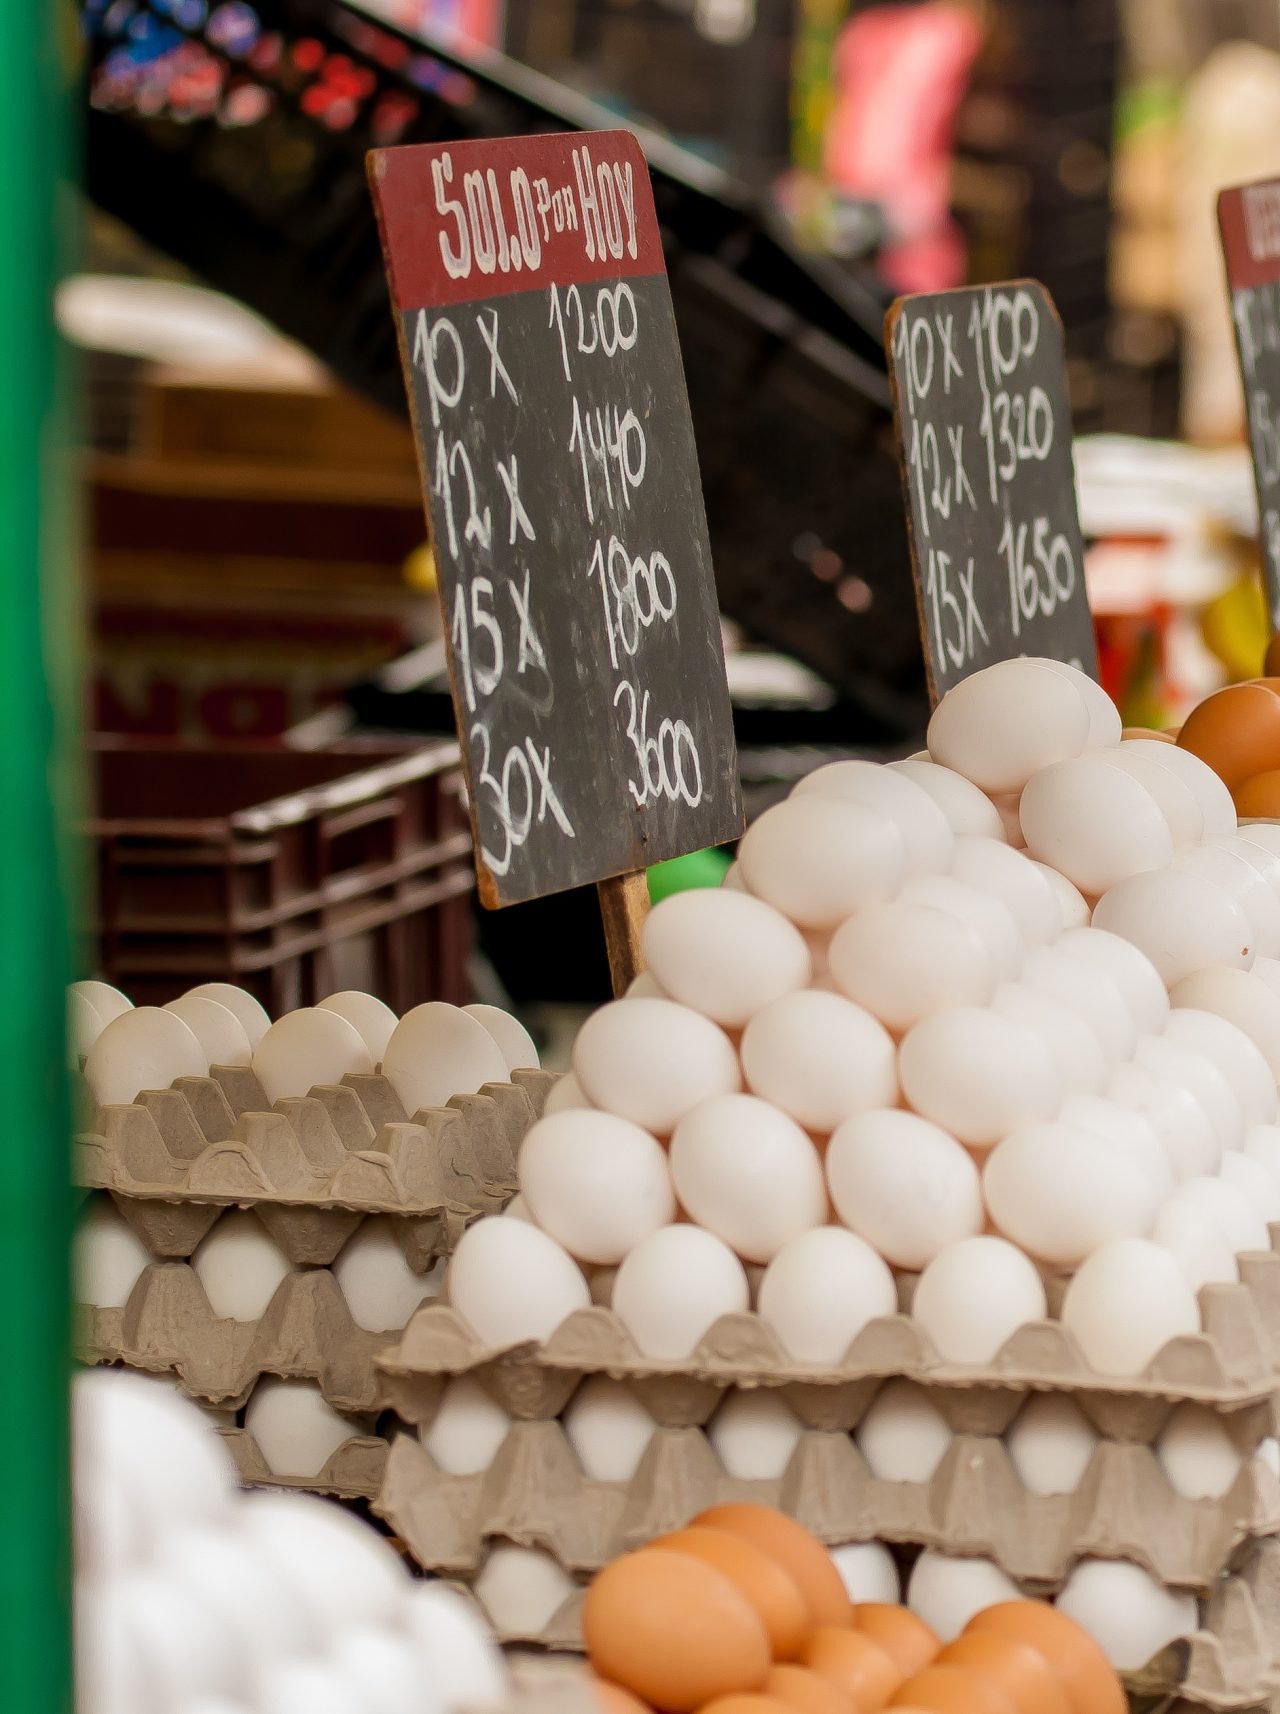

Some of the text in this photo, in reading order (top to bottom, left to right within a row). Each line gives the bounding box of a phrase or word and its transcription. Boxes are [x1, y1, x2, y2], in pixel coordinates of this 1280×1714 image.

[431, 151, 541, 280] SOLO
[572, 145, 638, 262] HOY
[548, 281, 638, 382] 1200
[569, 395, 646, 525] 1440
[979, 386, 1054, 505] 1320
[588, 535, 677, 670] 1800
[998, 516, 1075, 637] 1650
[614, 679, 703, 808] 3600
